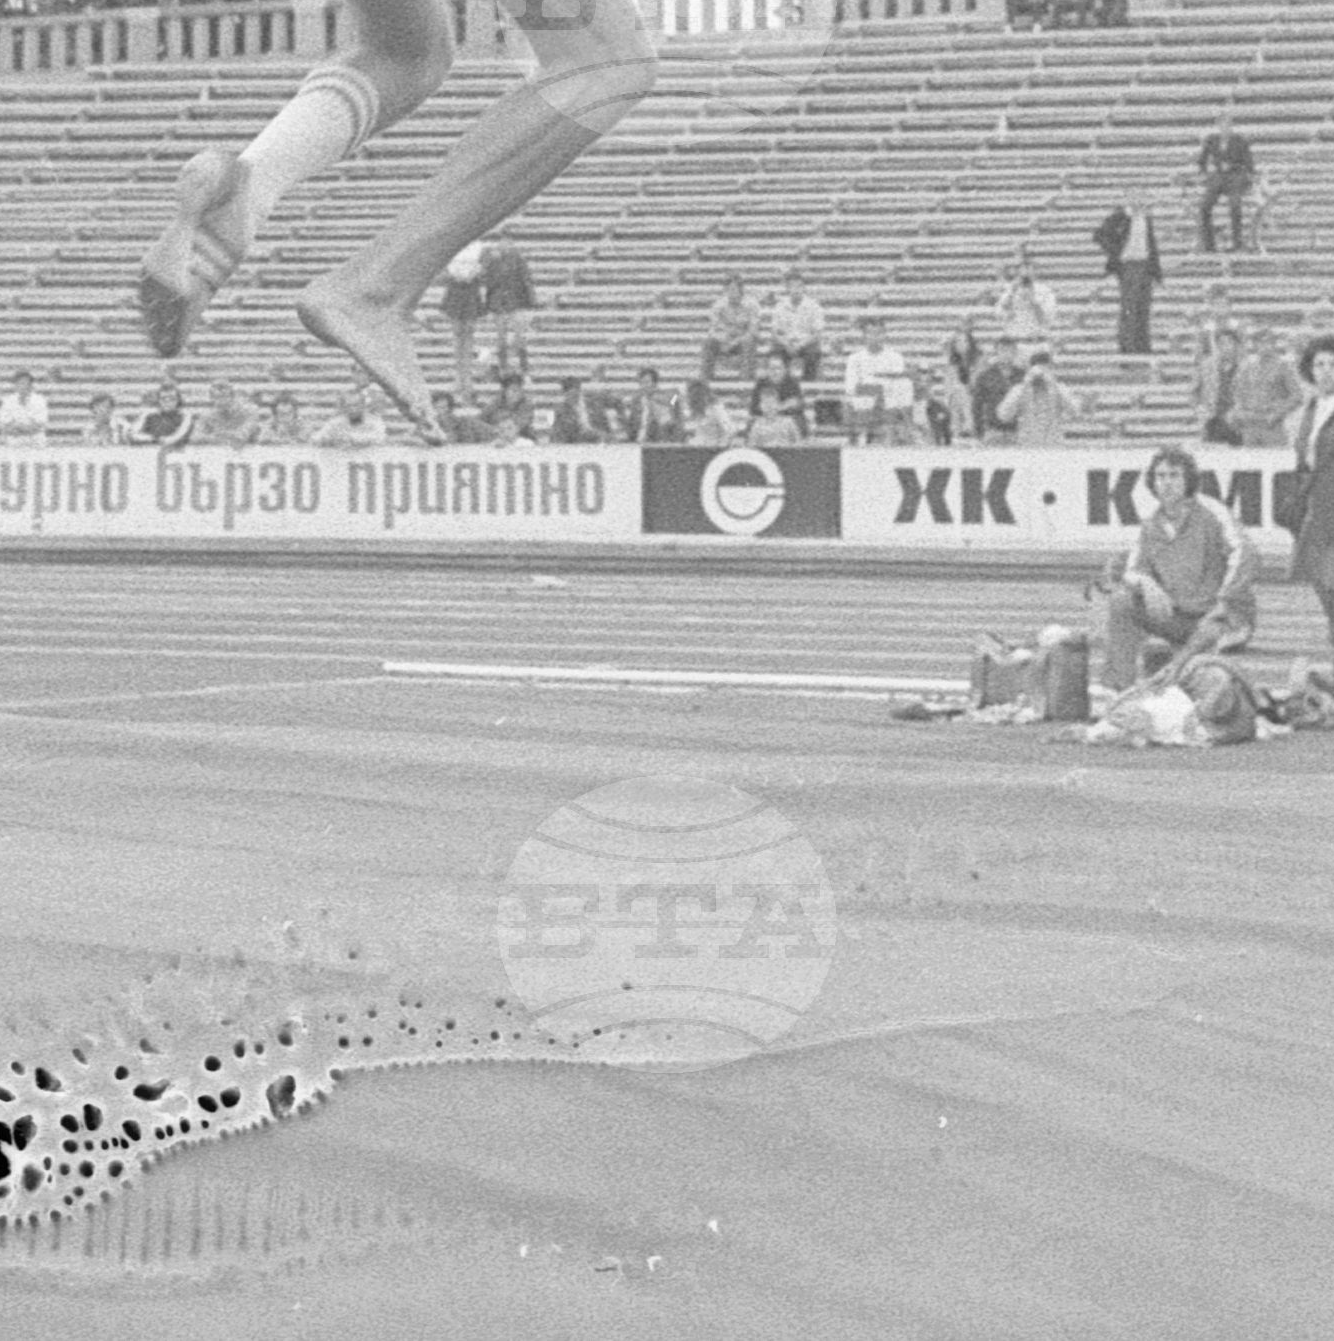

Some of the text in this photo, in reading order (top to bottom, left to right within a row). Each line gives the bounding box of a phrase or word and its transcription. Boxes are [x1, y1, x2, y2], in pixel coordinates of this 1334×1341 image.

[154, 447, 322, 531] бързо
[346, 460, 606, 532] приятно
[893, 468, 1017, 524] ХК
